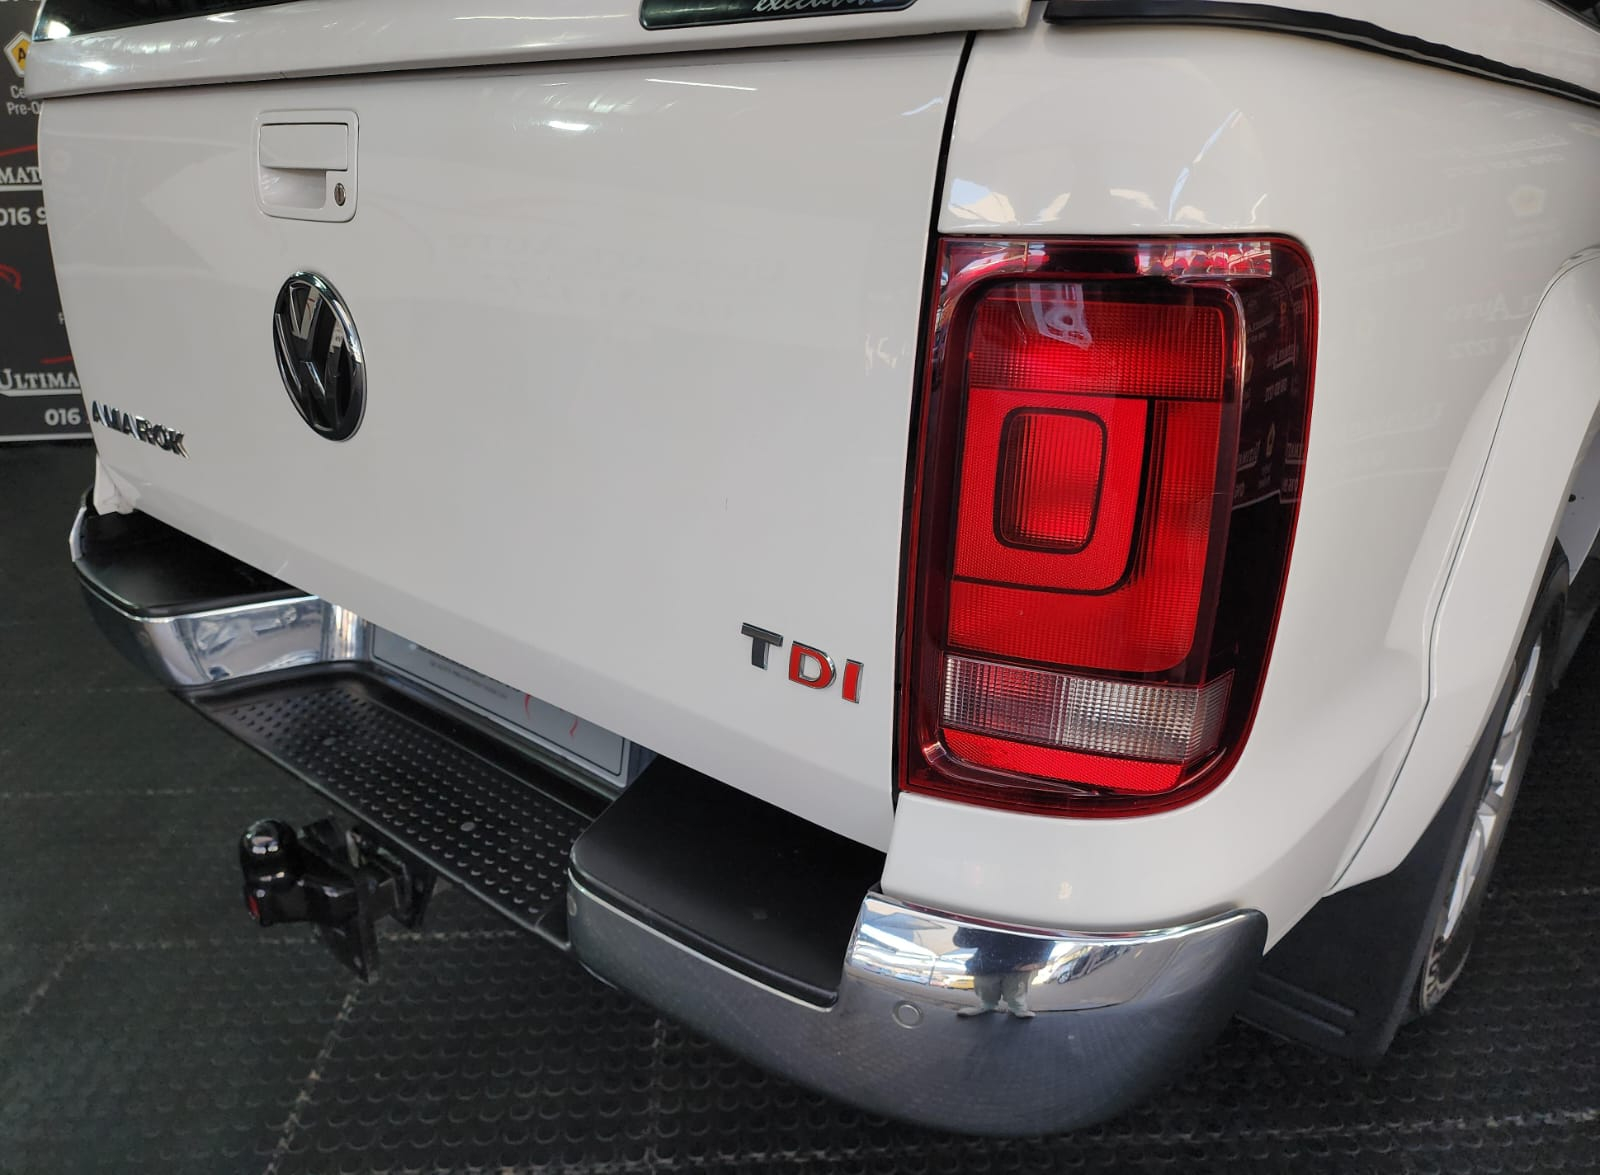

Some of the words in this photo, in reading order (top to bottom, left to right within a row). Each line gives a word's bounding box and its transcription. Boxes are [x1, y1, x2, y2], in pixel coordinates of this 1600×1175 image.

[44, 407, 81, 426] 016
[92, 400, 189, 459] AMAROK
[741, 622, 864, 704] TDI
